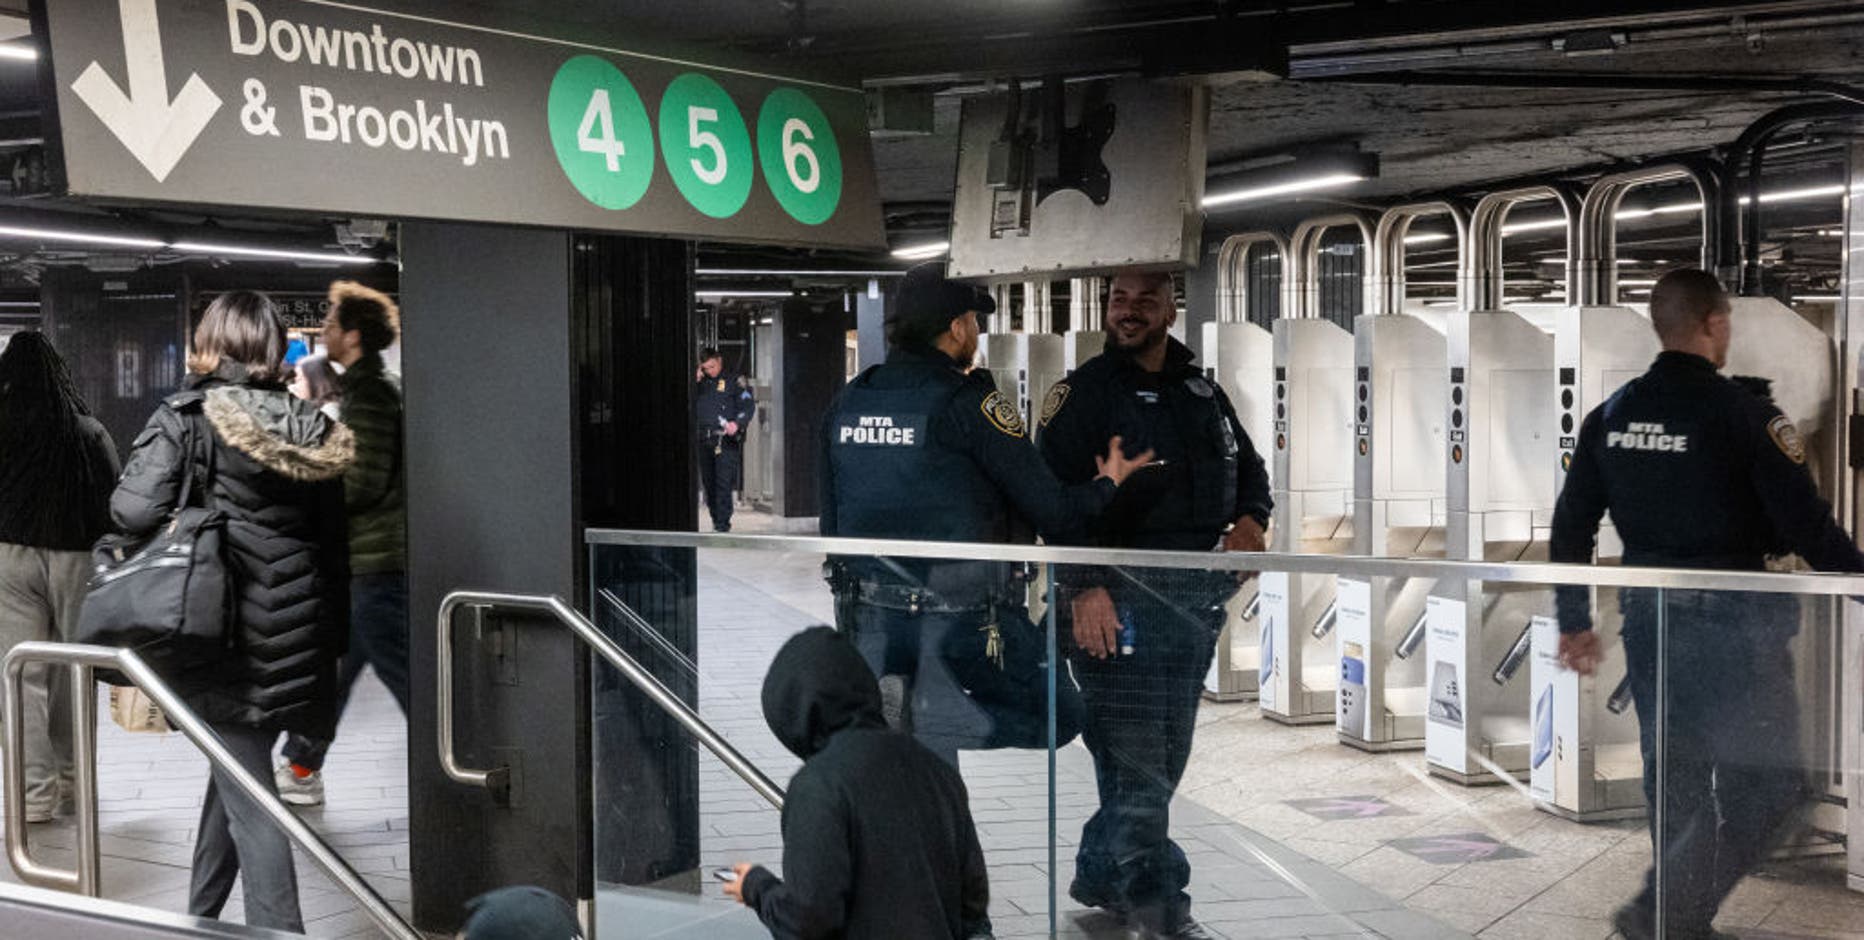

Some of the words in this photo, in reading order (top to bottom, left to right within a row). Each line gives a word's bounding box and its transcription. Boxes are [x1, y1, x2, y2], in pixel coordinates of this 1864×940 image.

[227, 0, 484, 86] Downtown
[240, 77, 281, 137] &
[299, 85, 510, 166] Brooklyn
[577, 88, 625, 172] 4
[688, 105, 728, 185] 5
[782, 117, 820, 194] 6
[860, 416, 893, 427] MTA
[1628, 422, 1665, 434] MTA
[840, 426, 915, 445] POLICE
[1607, 431, 1688, 453] POLICE
